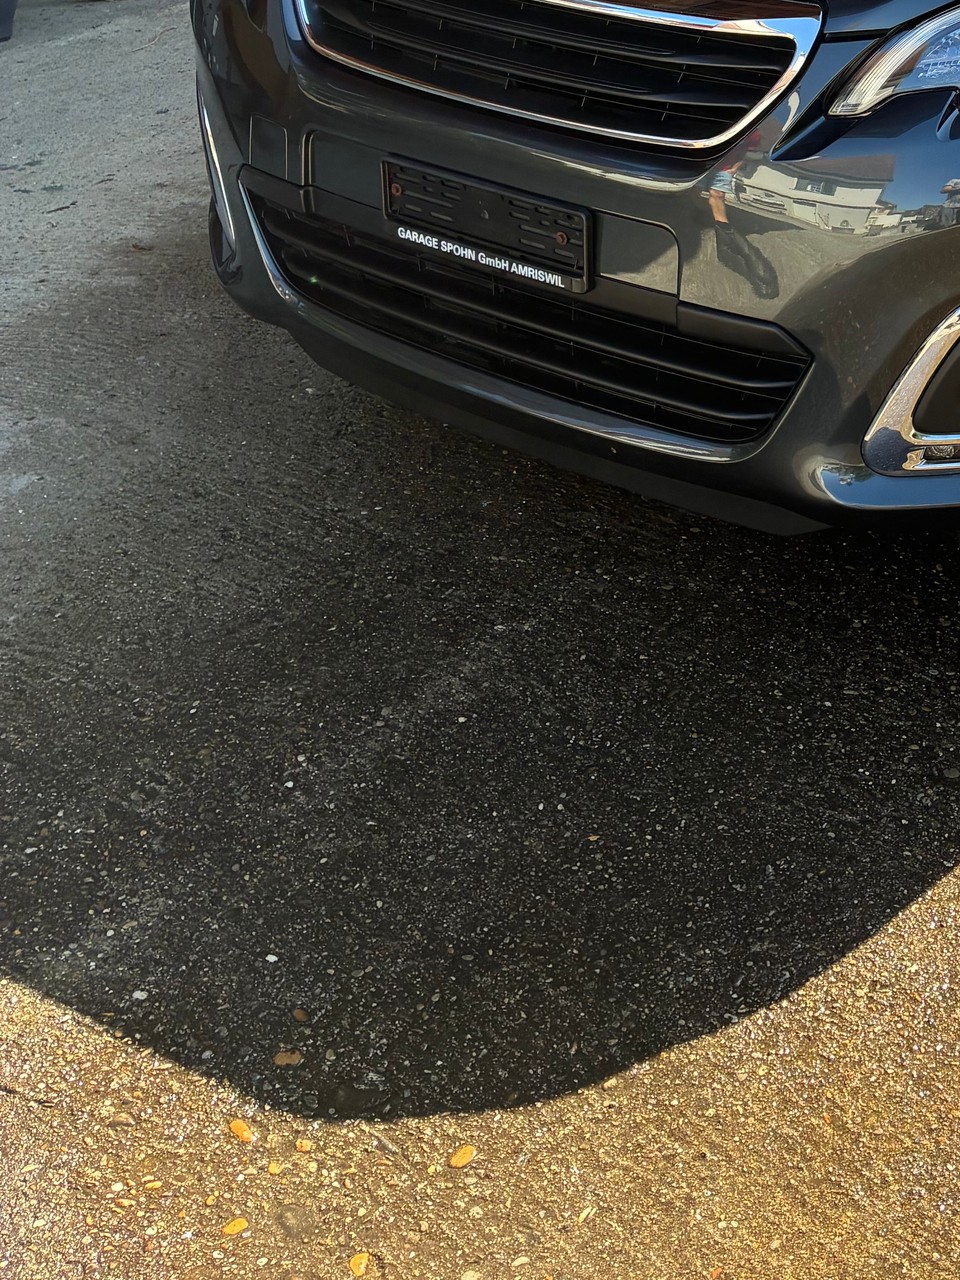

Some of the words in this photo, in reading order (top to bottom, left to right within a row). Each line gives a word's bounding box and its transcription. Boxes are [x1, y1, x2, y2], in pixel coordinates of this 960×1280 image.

[397, 227, 439, 249] GARAGE
[440, 241, 476, 261] SPOHN
[478, 252, 509, 271] GmbH
[510, 262, 565, 288] AMRISWIL
